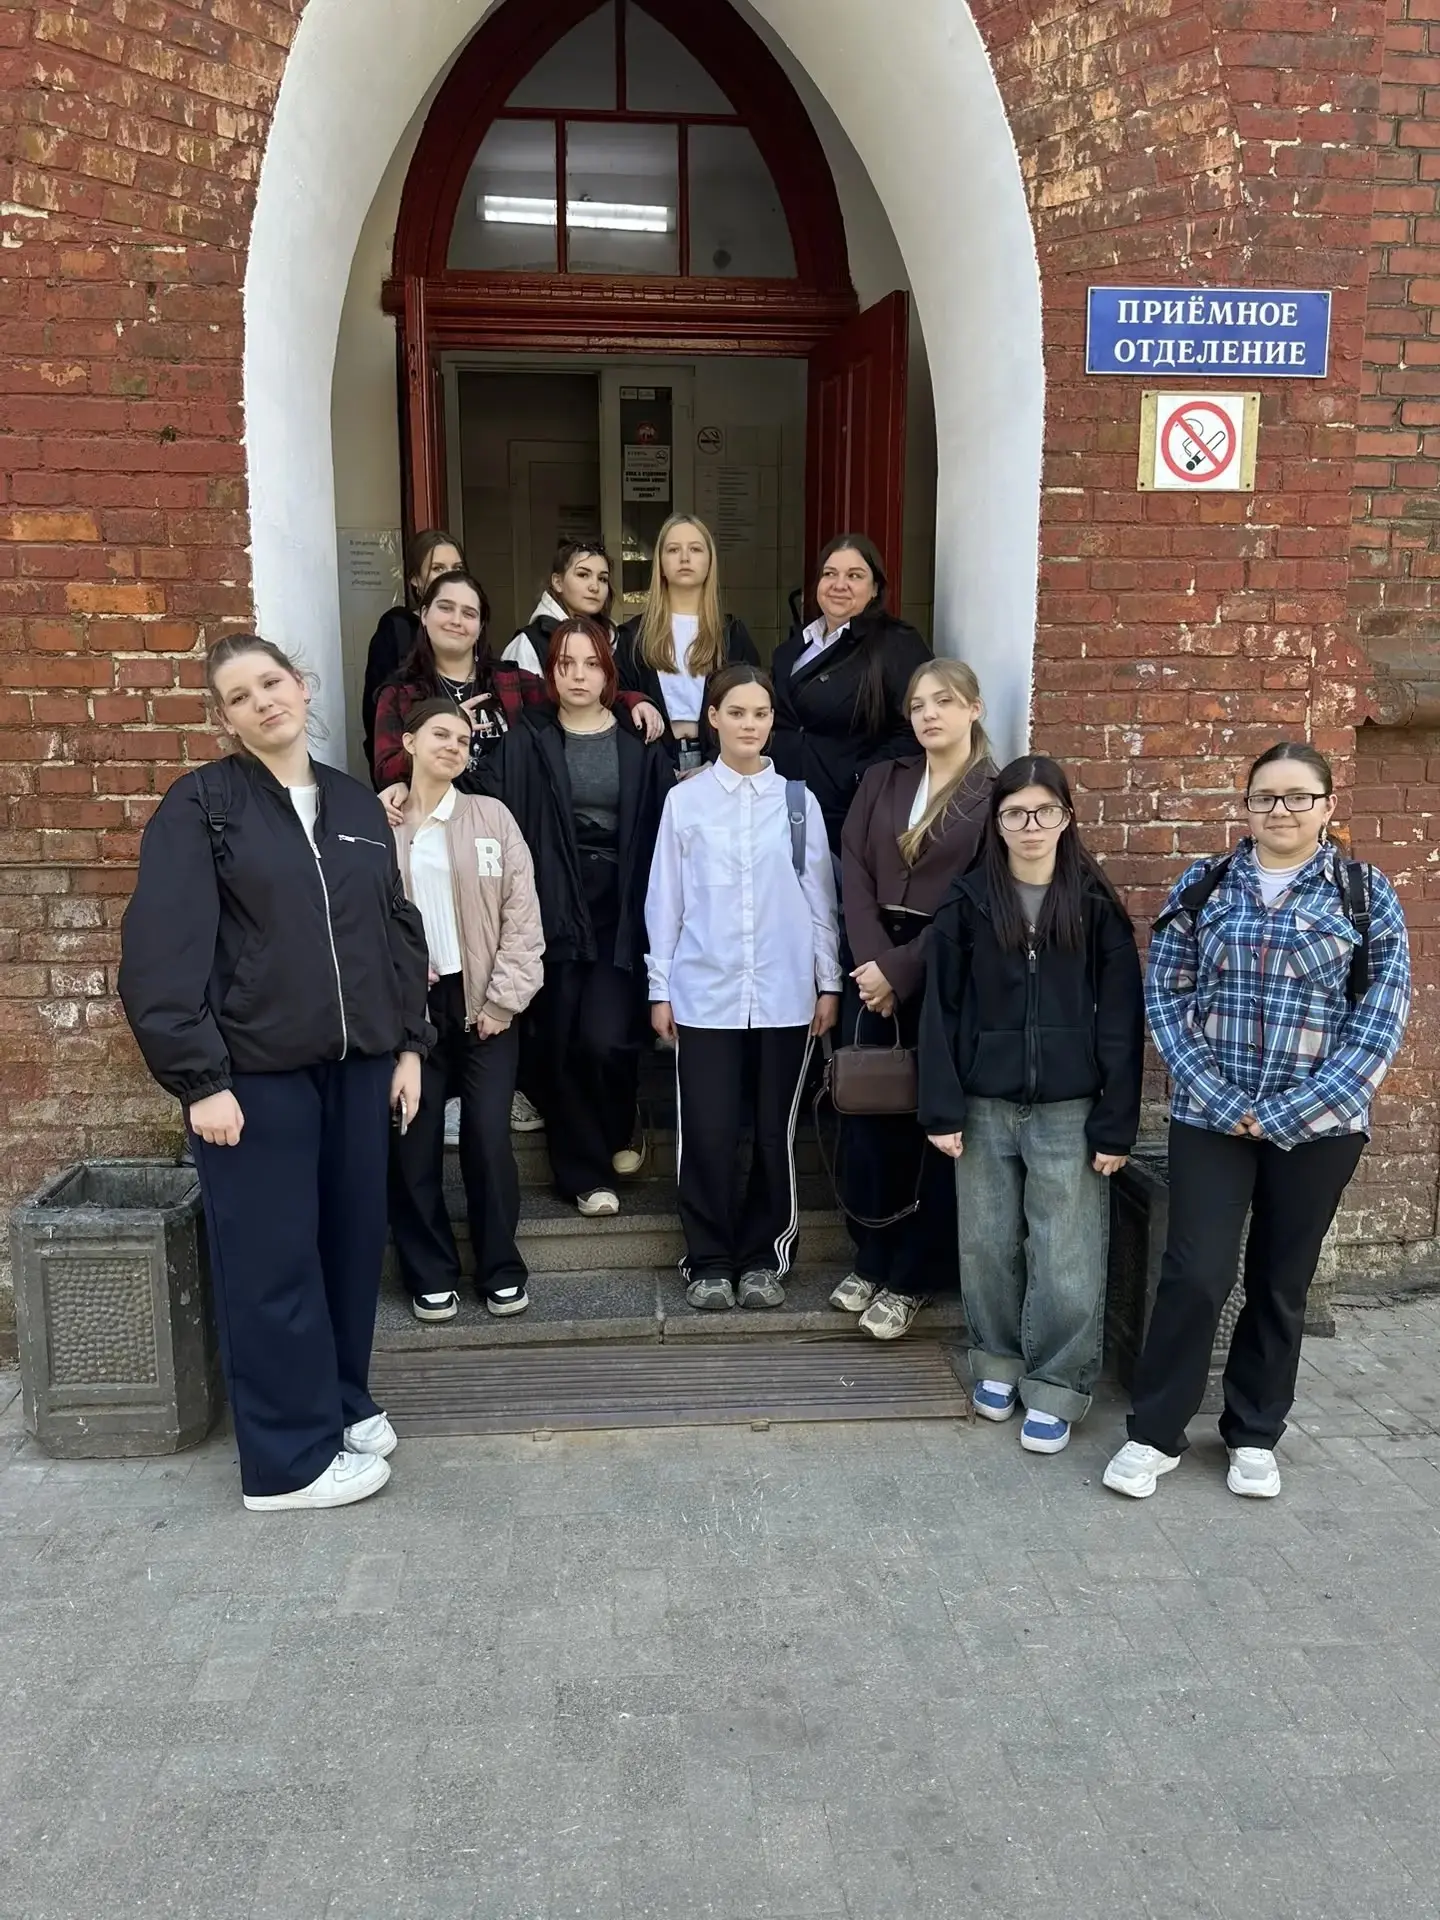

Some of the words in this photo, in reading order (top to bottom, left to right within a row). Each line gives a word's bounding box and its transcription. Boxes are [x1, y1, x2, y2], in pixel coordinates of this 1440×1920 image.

[1117, 296, 1298, 326] ПРИЁМНОЕ
[1114, 339, 1306, 367] ОТДЕЛЕНИЕ
[475, 837, 503, 877] R
